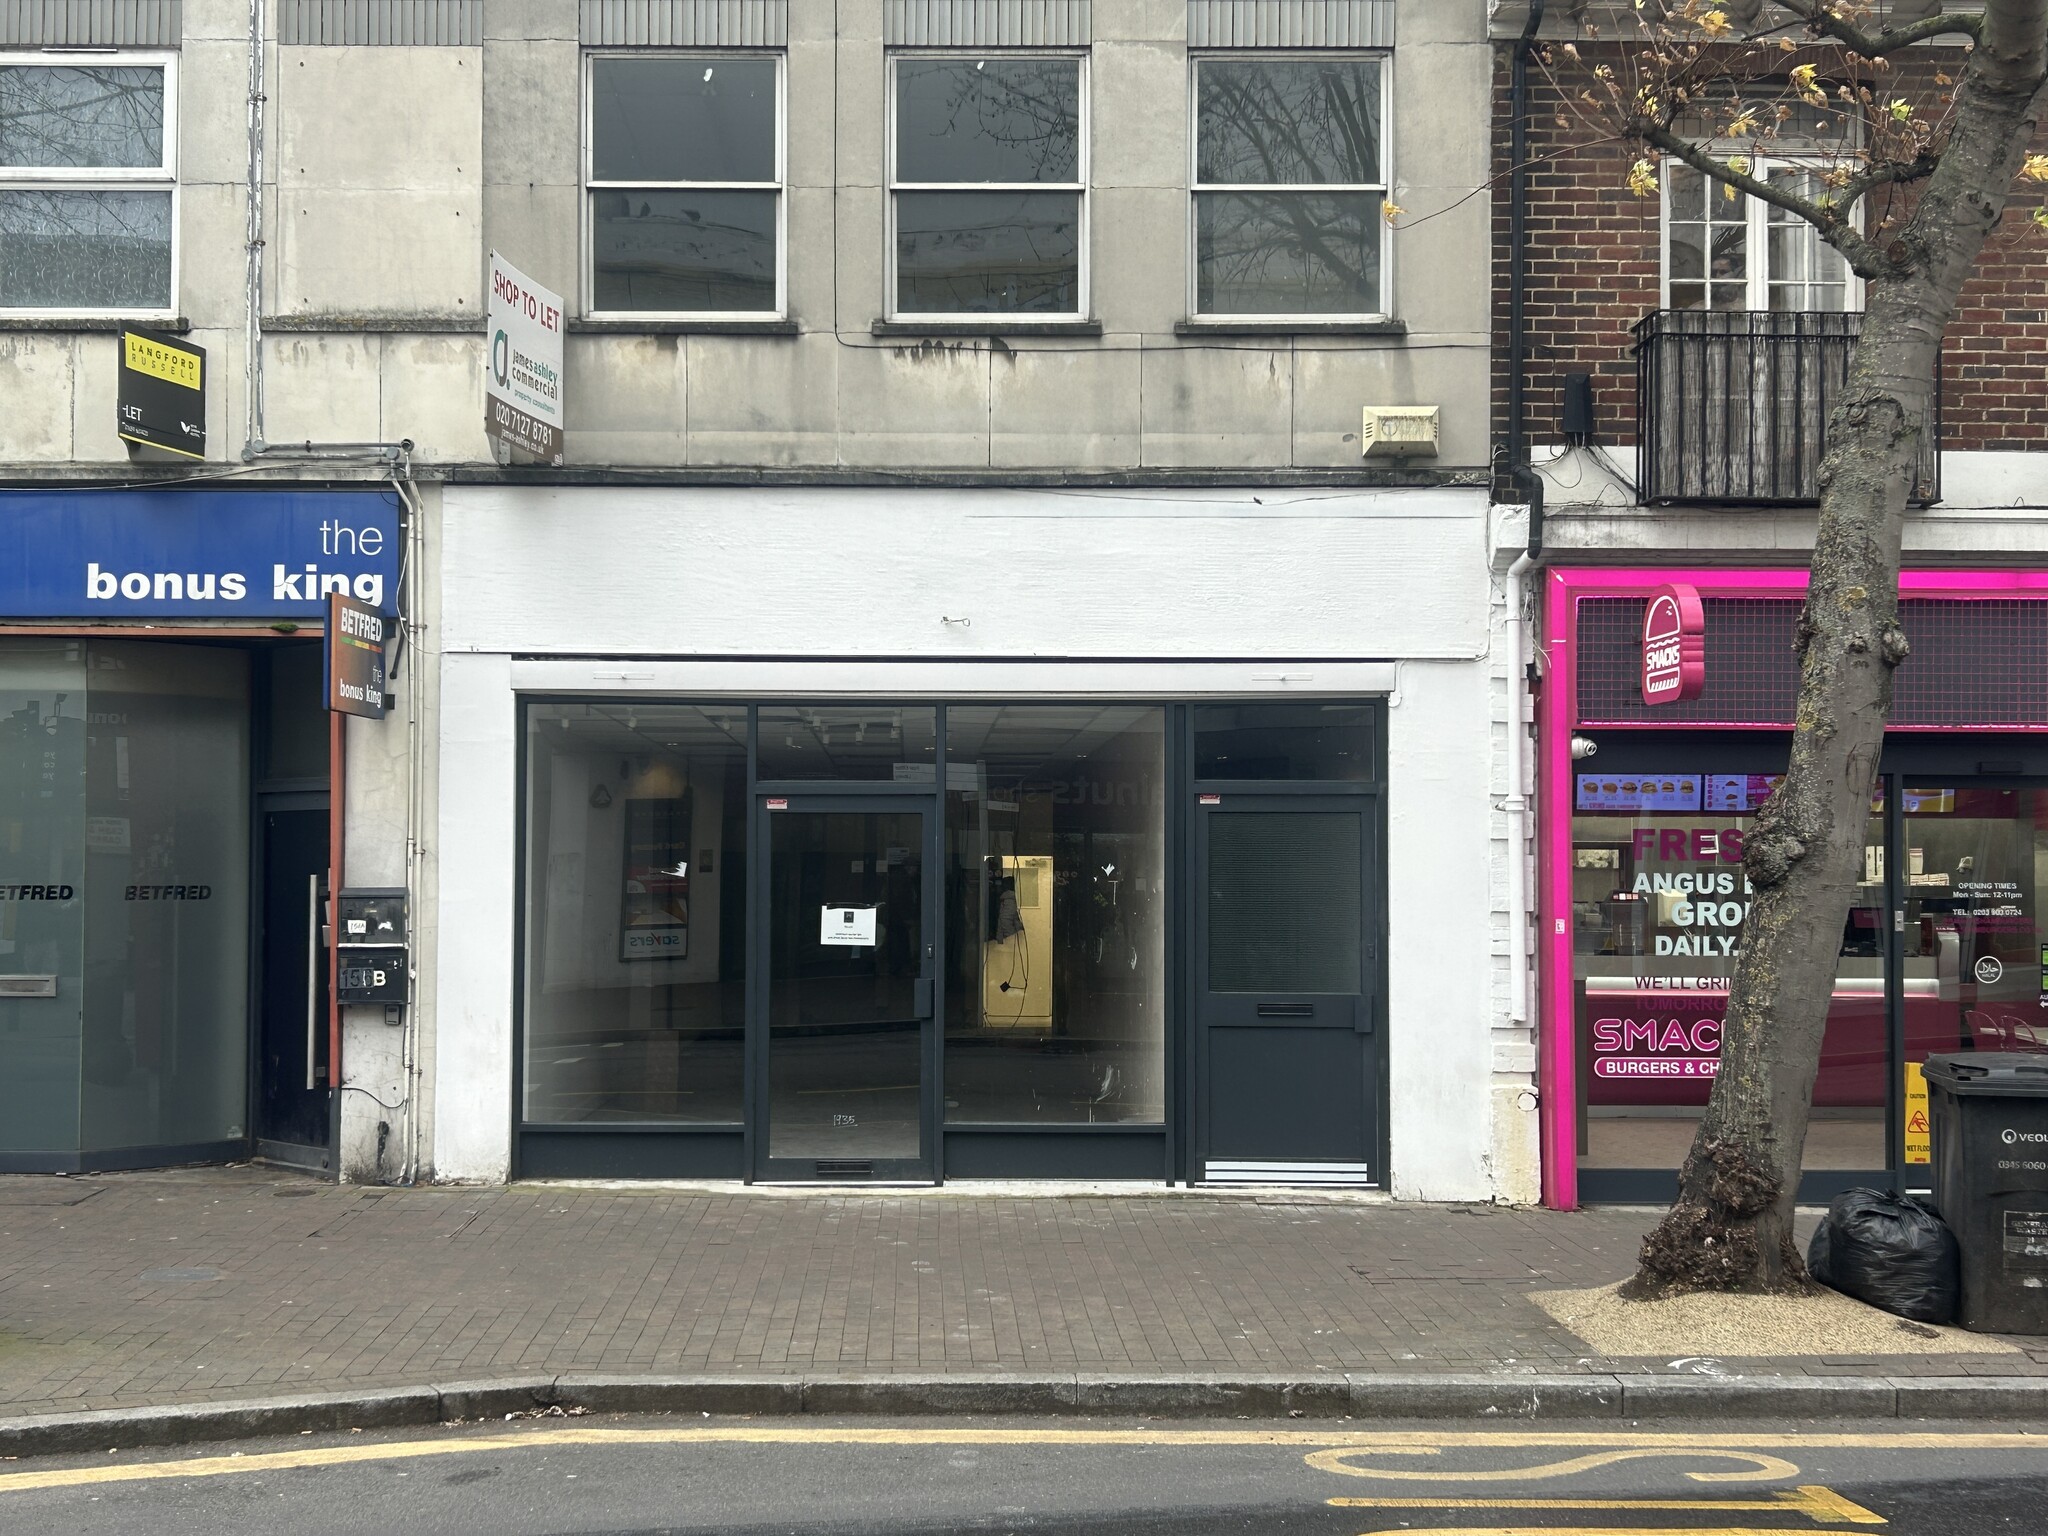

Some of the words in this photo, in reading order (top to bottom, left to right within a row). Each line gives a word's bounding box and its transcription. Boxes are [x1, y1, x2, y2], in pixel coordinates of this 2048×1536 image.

[494, 269, 519, 308] SHOP
[522, 290, 537, 320] TO
[540, 302, 560, 333] LET
[131, 341, 194, 370] LANGFORD
[131, 353, 194, 381] RUSSELL
[512, 366, 558, 401] commercial
[125, 404, 143, 421] LET
[495, 402, 510, 427] 020
[511, 410, 531, 437] 7127
[532, 421, 552, 446] 8781
[319, 518, 383, 556] the
[86, 563, 247, 600] bonus
[273, 563, 383, 607] king
[341, 606, 383, 642] BETFRED
[1646, 644, 1680, 672] SMACKS
[340, 678, 364, 701] bonus
[365, 683, 382, 709] king
[124, 885, 212, 901] BETFRED
[1632, 872, 1734, 895] ANGUS
[1958, 882, 1993, 890] OPENING
[1952, 908, 1970, 916] TEL:
[1655, 935, 1739, 957] DAILY.
[1634, 976, 1691, 990] WE'LL
[1606, 1061, 1680, 1074] BURGERS
[1684, 1061, 1695, 1074] &
[1699, 1061, 1720, 1074] CH
[1906, 1144, 1917, 1152] WET
[2019, 1133, 2048, 1143] VEOL
[1998, 1160, 2020, 1169] 0345
[2022, 1161, 2046, 1170] 6060
